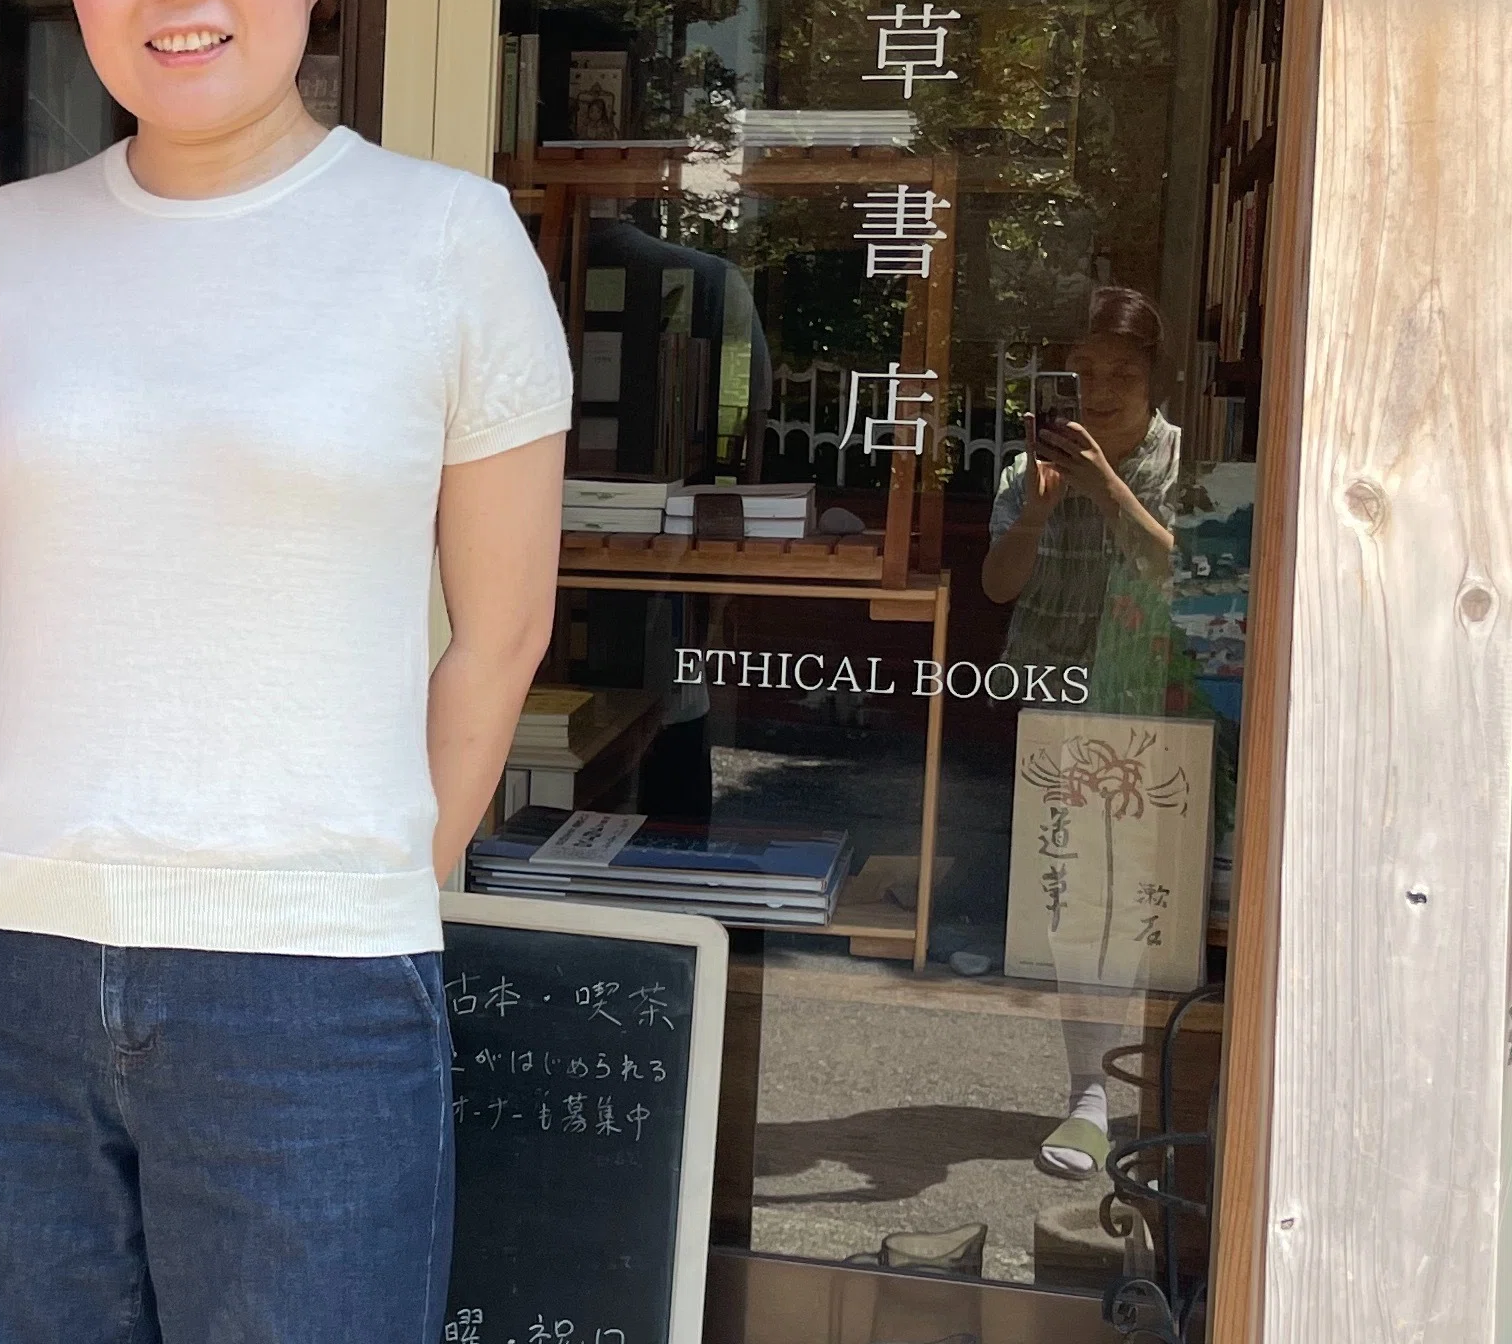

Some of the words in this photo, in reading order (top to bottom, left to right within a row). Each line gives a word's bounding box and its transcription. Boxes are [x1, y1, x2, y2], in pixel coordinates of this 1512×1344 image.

[673, 648, 895, 695] ETHICAL
[911, 659, 1090, 704] BOOKS
[1038, 807, 1079, 933] 道草
[1134, 881, 1171, 946] 漱石
